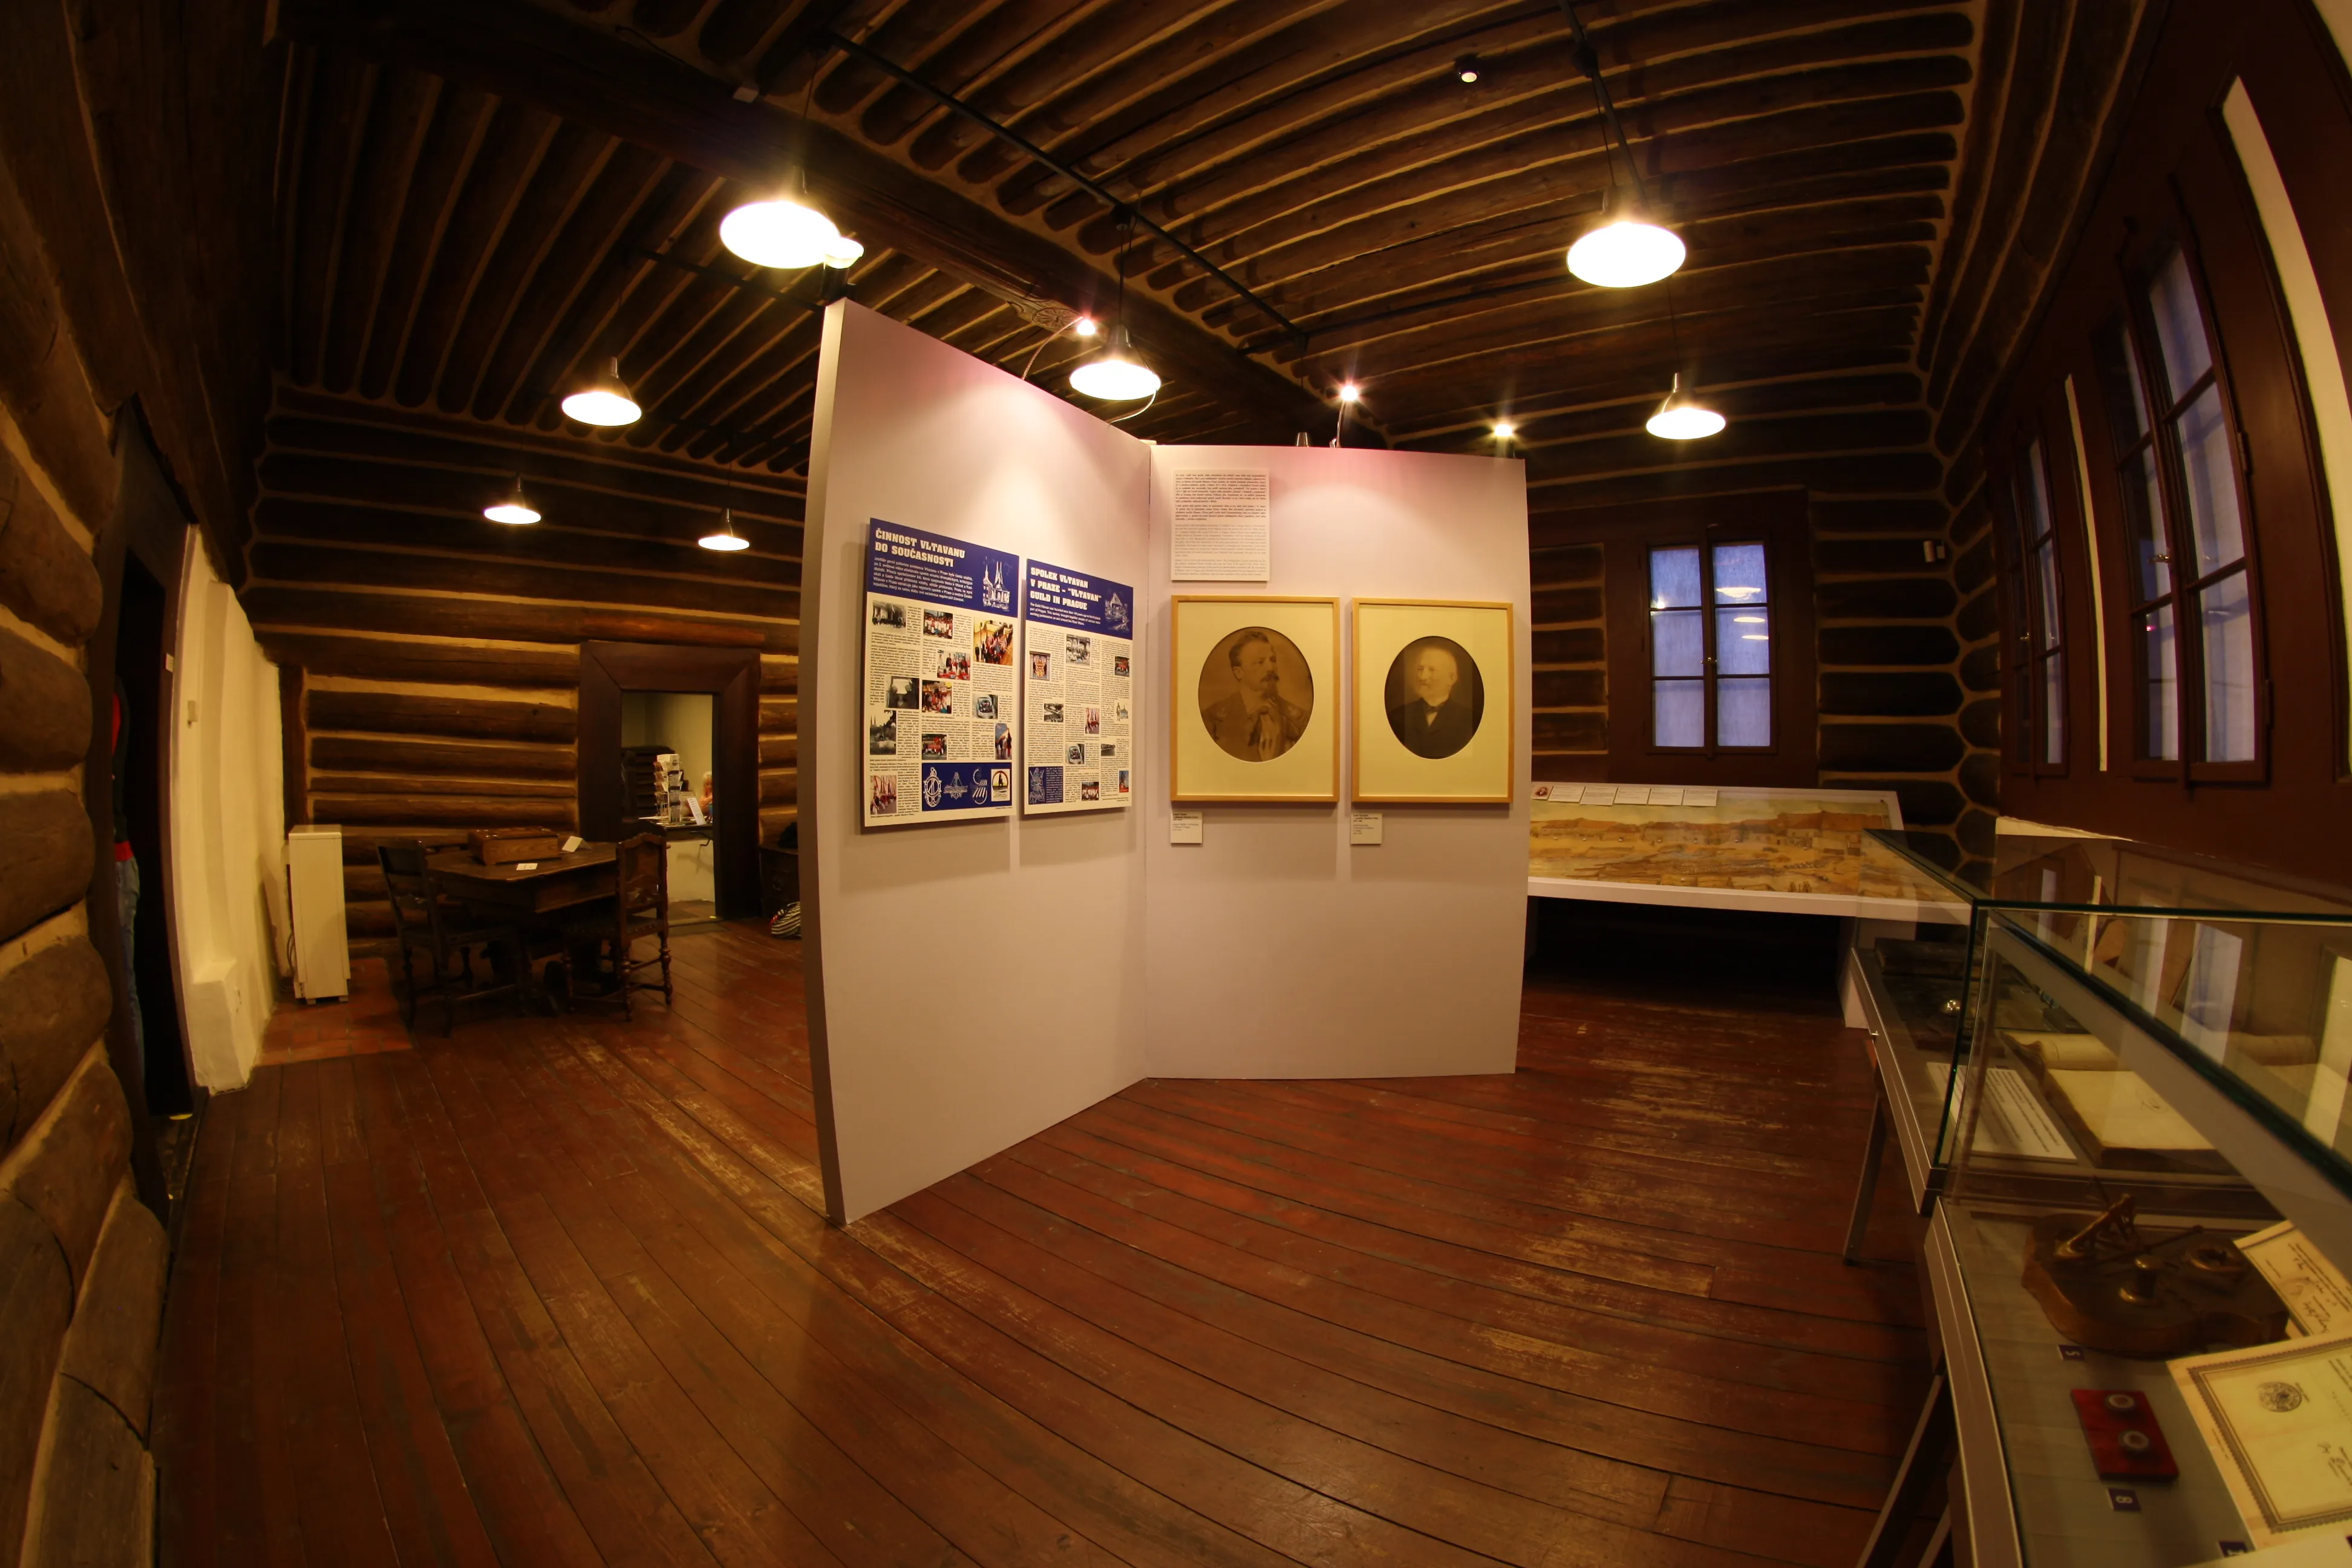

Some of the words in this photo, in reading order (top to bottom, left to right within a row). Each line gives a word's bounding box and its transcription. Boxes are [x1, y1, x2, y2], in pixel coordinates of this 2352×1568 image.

[875, 527, 917, 547] ČINNOST
[920, 540, 965, 559] VLTAVANU
[875, 541, 889, 553] DO
[891, 546, 954, 567] SOUČASNOSTI
[1030, 567, 1058, 581] SPOLEK
[1059, 574, 1088, 589] VLTAVAN
[1030, 578, 1036, 587] V
[1037, 580, 1060, 593] PRAZE
[1030, 590, 1051, 603] GUILD
[1053, 595, 1060, 604] IN
[1062, 597, 1088, 610] PRAGUE
[2115, 1495, 2133, 1504] 8
